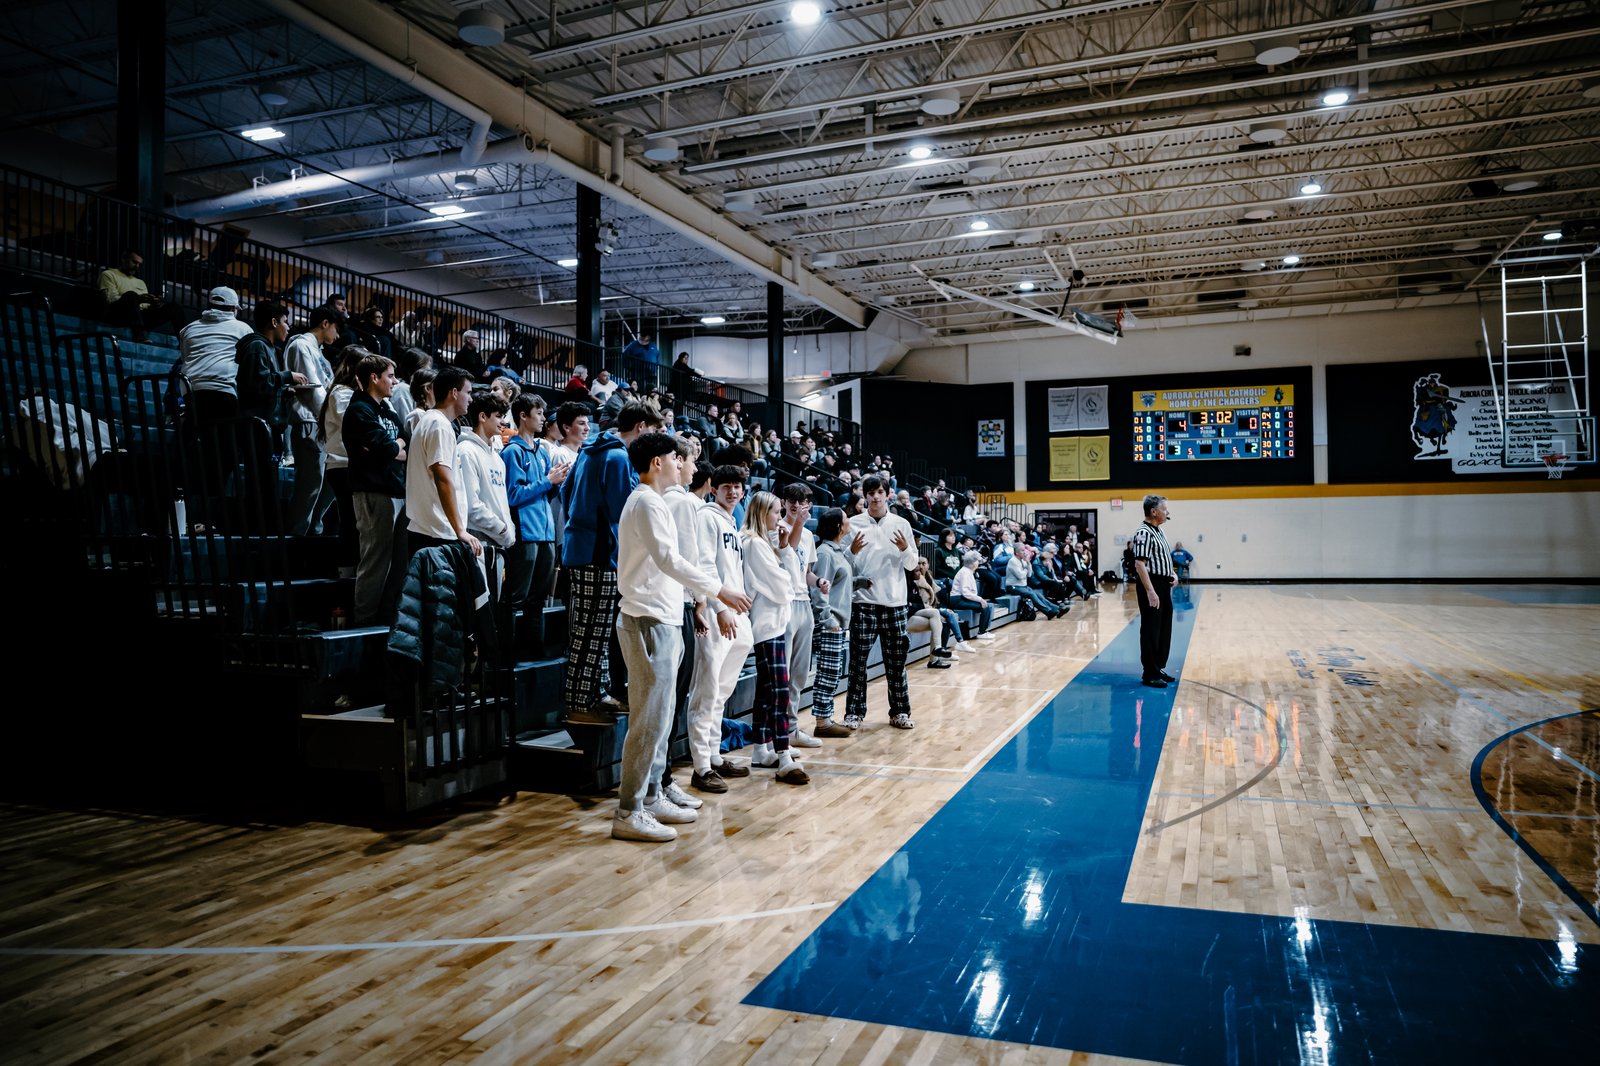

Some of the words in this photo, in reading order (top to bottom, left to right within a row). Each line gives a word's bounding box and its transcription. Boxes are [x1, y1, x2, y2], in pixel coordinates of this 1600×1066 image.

[1162, 392, 1193, 400] AURORA
[1194, 390, 1228, 399] CENTRAL
[1229, 388, 1267, 397] CATHOLIC
[1460, 390, 1480, 398] AURORA
[1169, 400, 1190, 408] HOME
[1203, 399, 1217, 407] THE
[1218, 397, 1260, 406] CHARGERS
[1519, 397, 1546, 405] SONG
[1200, 411, 1233, 425] 3:02
[1261, 412, 1272, 420] 04
[1274, 411, 1280, 419] 0
[1289, 411, 1294, 419] 0
[1146, 416, 1152, 424] 0
[1249, 417, 1257, 430] 0
[1146, 425, 1152, 433] 0
[1178, 420, 1187, 432] 4
[1274, 421, 1280, 429] 0
[1146, 434, 1152, 442] 0
[1289, 430, 1294, 438] 0
[1159, 443, 1164, 451] 0
[1251, 443, 1259, 453] 2
[1262, 440, 1272, 448] 30
[1275, 440, 1281, 448] 0
[1289, 440, 1294, 448] 0
[1174, 445, 1182, 456] 3
[1289, 449, 1294, 457] 0
[1146, 453, 1152, 461] 0
